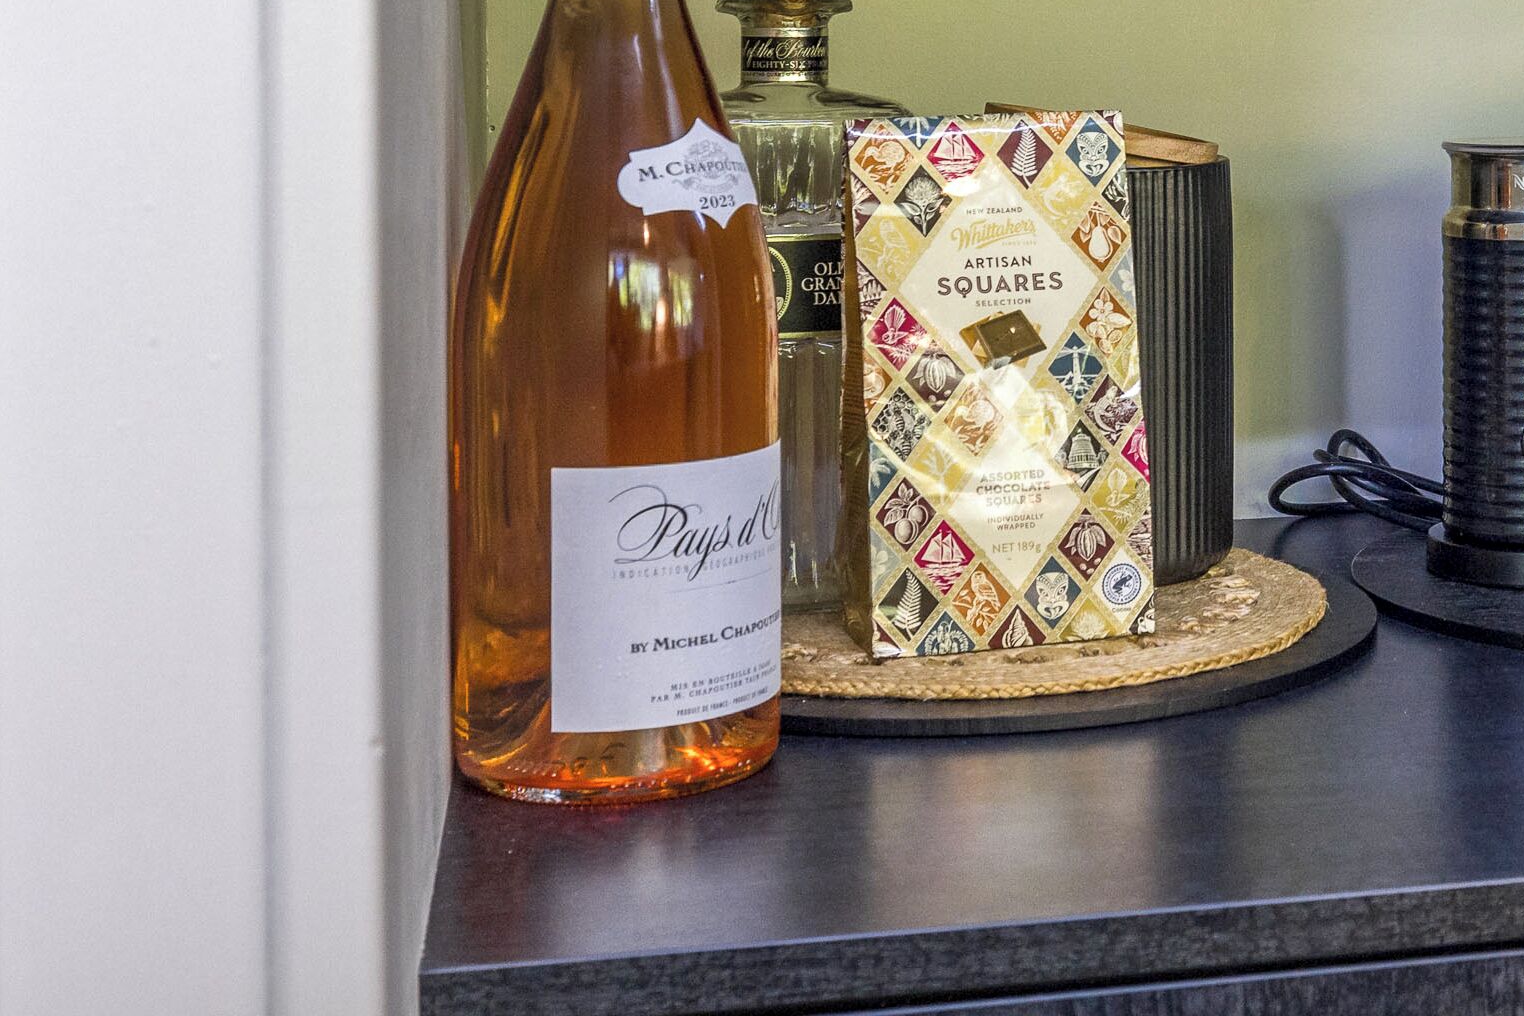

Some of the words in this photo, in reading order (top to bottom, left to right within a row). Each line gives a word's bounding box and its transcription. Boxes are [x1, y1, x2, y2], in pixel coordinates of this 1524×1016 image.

[699, 195, 735, 210] 2023
[986, 206, 1023, 214] ZEALAND
[964, 255, 1032, 270] ARTISAN
[937, 271, 1063, 299] SQUARES
[975, 297, 1032, 307] SELECTION
[980, 469, 1045, 483] ASSORTED
[976, 481, 1051, 496] CHOCOLATE
[987, 513, 1044, 524] INDIVIDUALLY
[609, 484, 734, 582] Pays
[996, 522, 1036, 532] WRAPPED
[992, 542, 1015, 554] NET
[630, 642, 648, 654] BY
[653, 634, 718, 652] MICHEL
